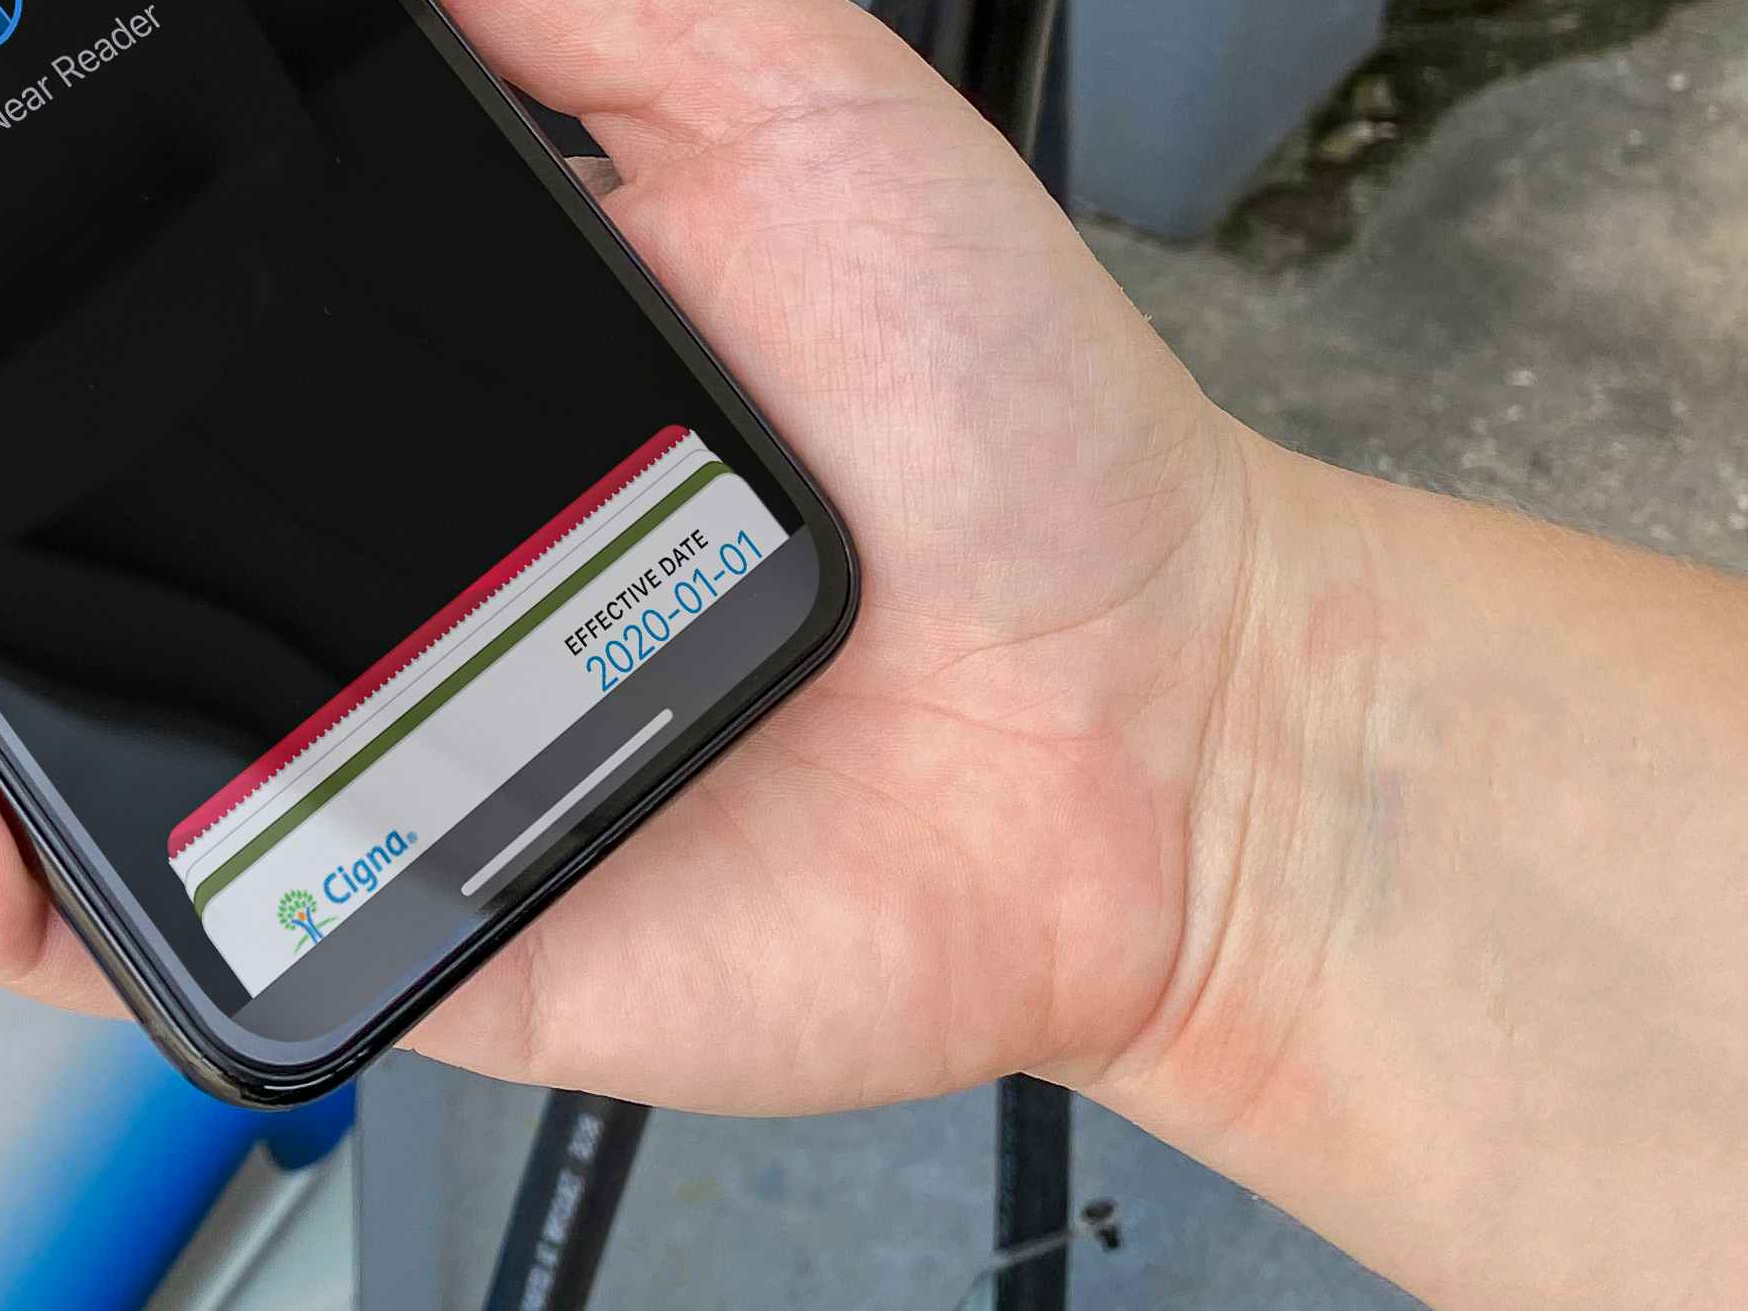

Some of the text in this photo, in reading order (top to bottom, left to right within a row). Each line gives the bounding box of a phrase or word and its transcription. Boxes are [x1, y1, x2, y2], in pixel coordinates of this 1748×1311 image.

[50, 4, 161, 88] Reader
[563, 528, 710, 657] EFFECTIVE DATE
[585, 529, 764, 693] 2020-01-01
